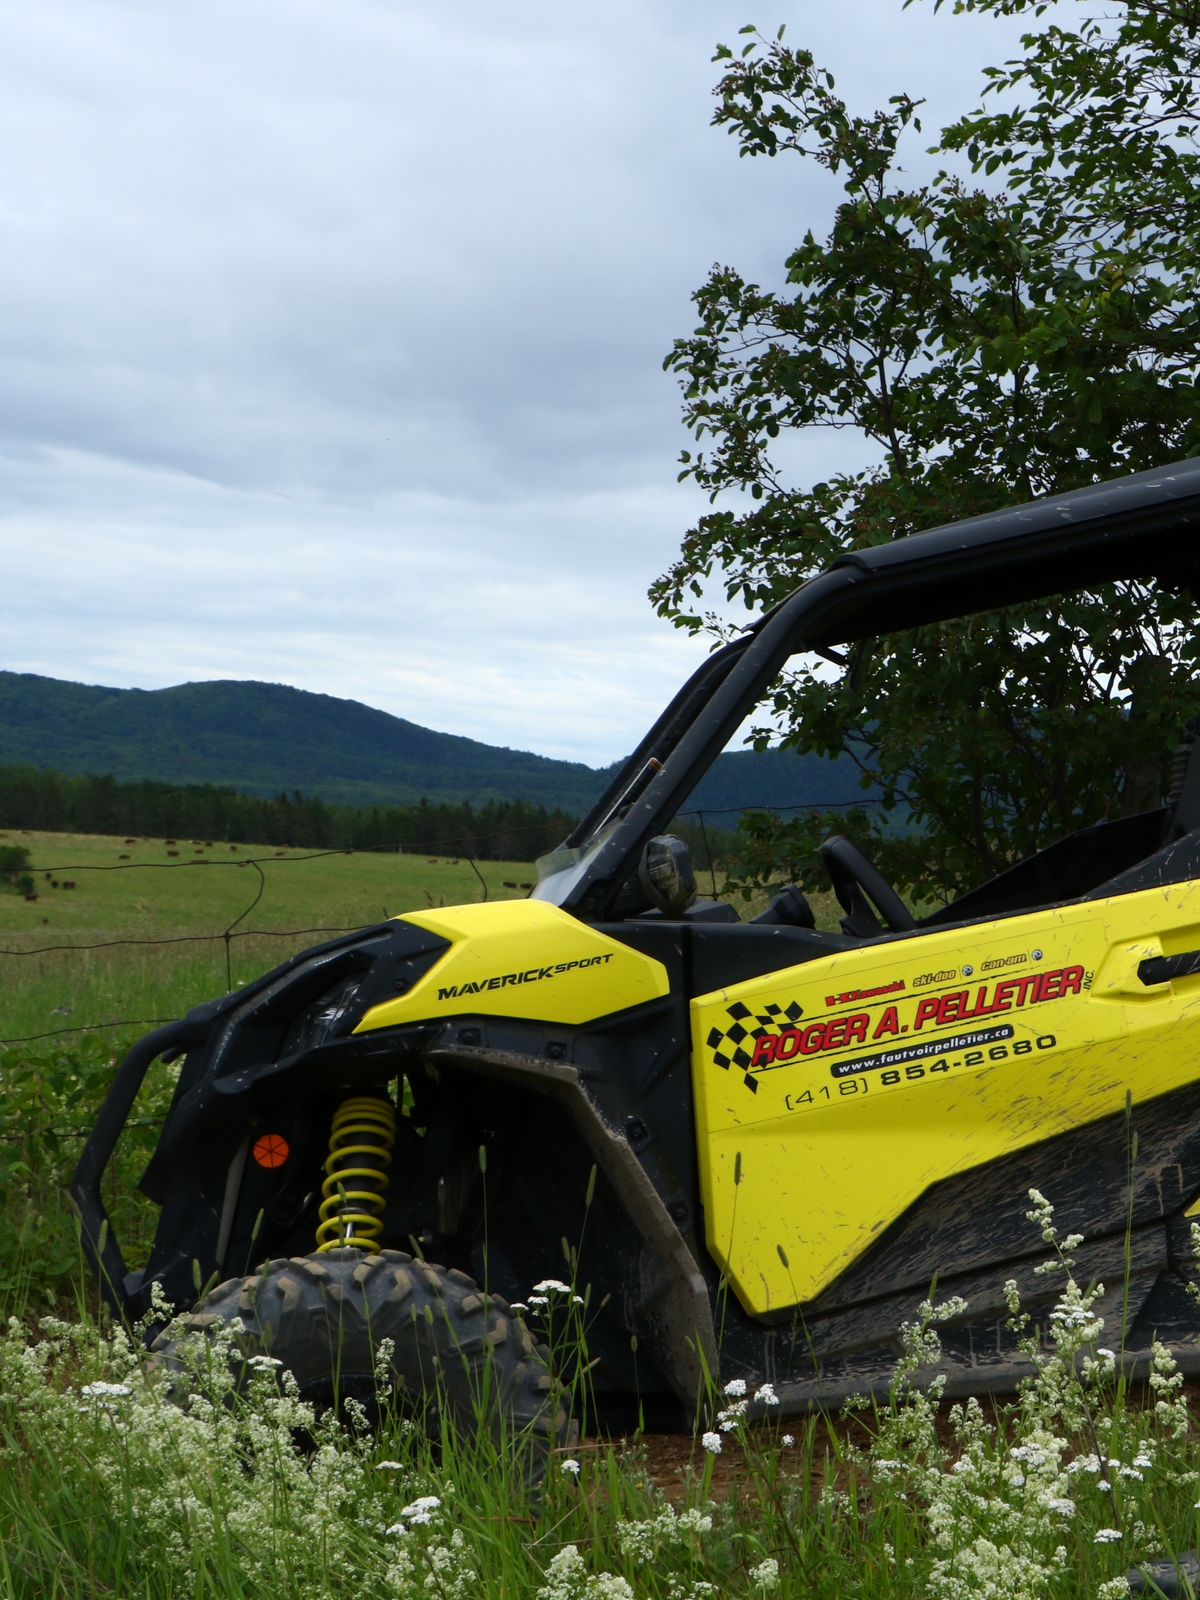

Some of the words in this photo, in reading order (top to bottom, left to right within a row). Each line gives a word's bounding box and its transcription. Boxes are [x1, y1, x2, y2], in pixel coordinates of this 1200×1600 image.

[981, 954, 1027, 971] can-am
[913, 970, 956, 987] ski-doo
[1083, 970, 1095, 990] INC.
[850, 980, 905, 1000] Kawasaki
[751, 1013, 870, 1066] ROGER
[872, 1006, 909, 1039] A.
[914, 965, 1085, 1030] PELLETIER
[838, 1027, 1009, 1074] www.fautvoirpelletier.ca
[785, 1077, 869, 1110] (418)
[880, 1034, 1057, 1087] 854-2680
